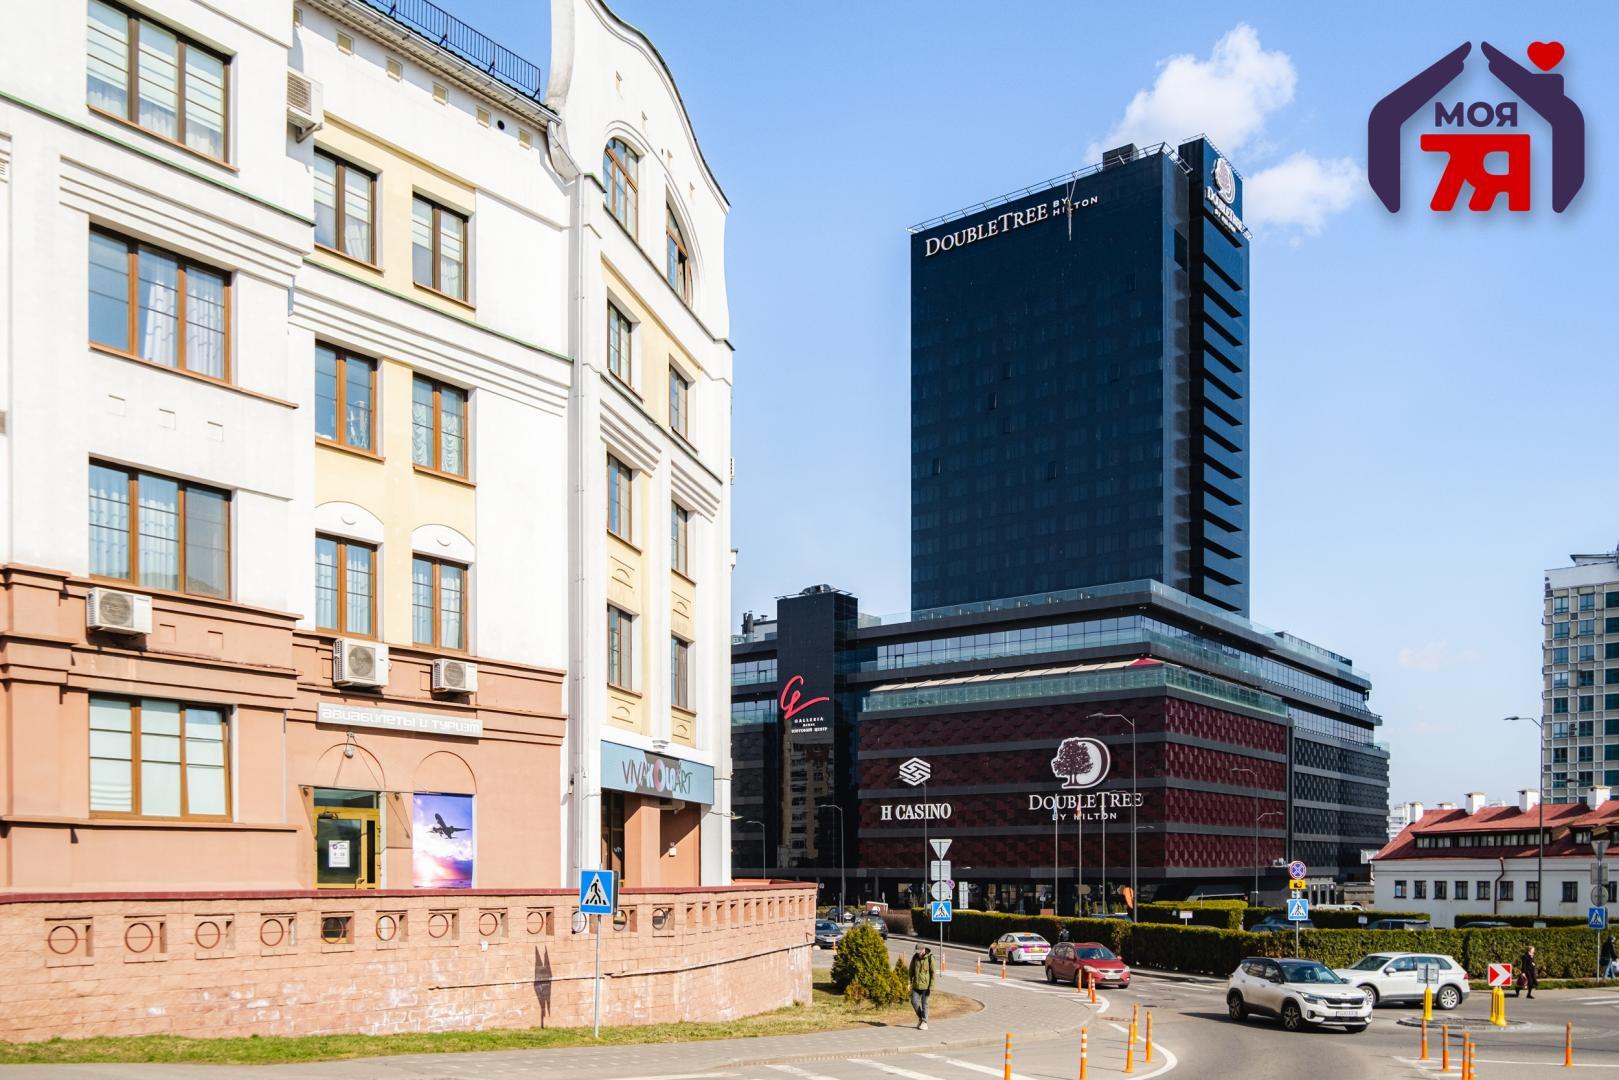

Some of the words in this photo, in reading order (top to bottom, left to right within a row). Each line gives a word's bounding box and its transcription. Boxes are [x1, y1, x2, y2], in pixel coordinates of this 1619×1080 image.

[1053, 196, 1069, 208] BY
[794, 716, 824, 724] GALLERIA
[880, 805, 893, 821] H
[895, 802, 953, 820] CASINO
